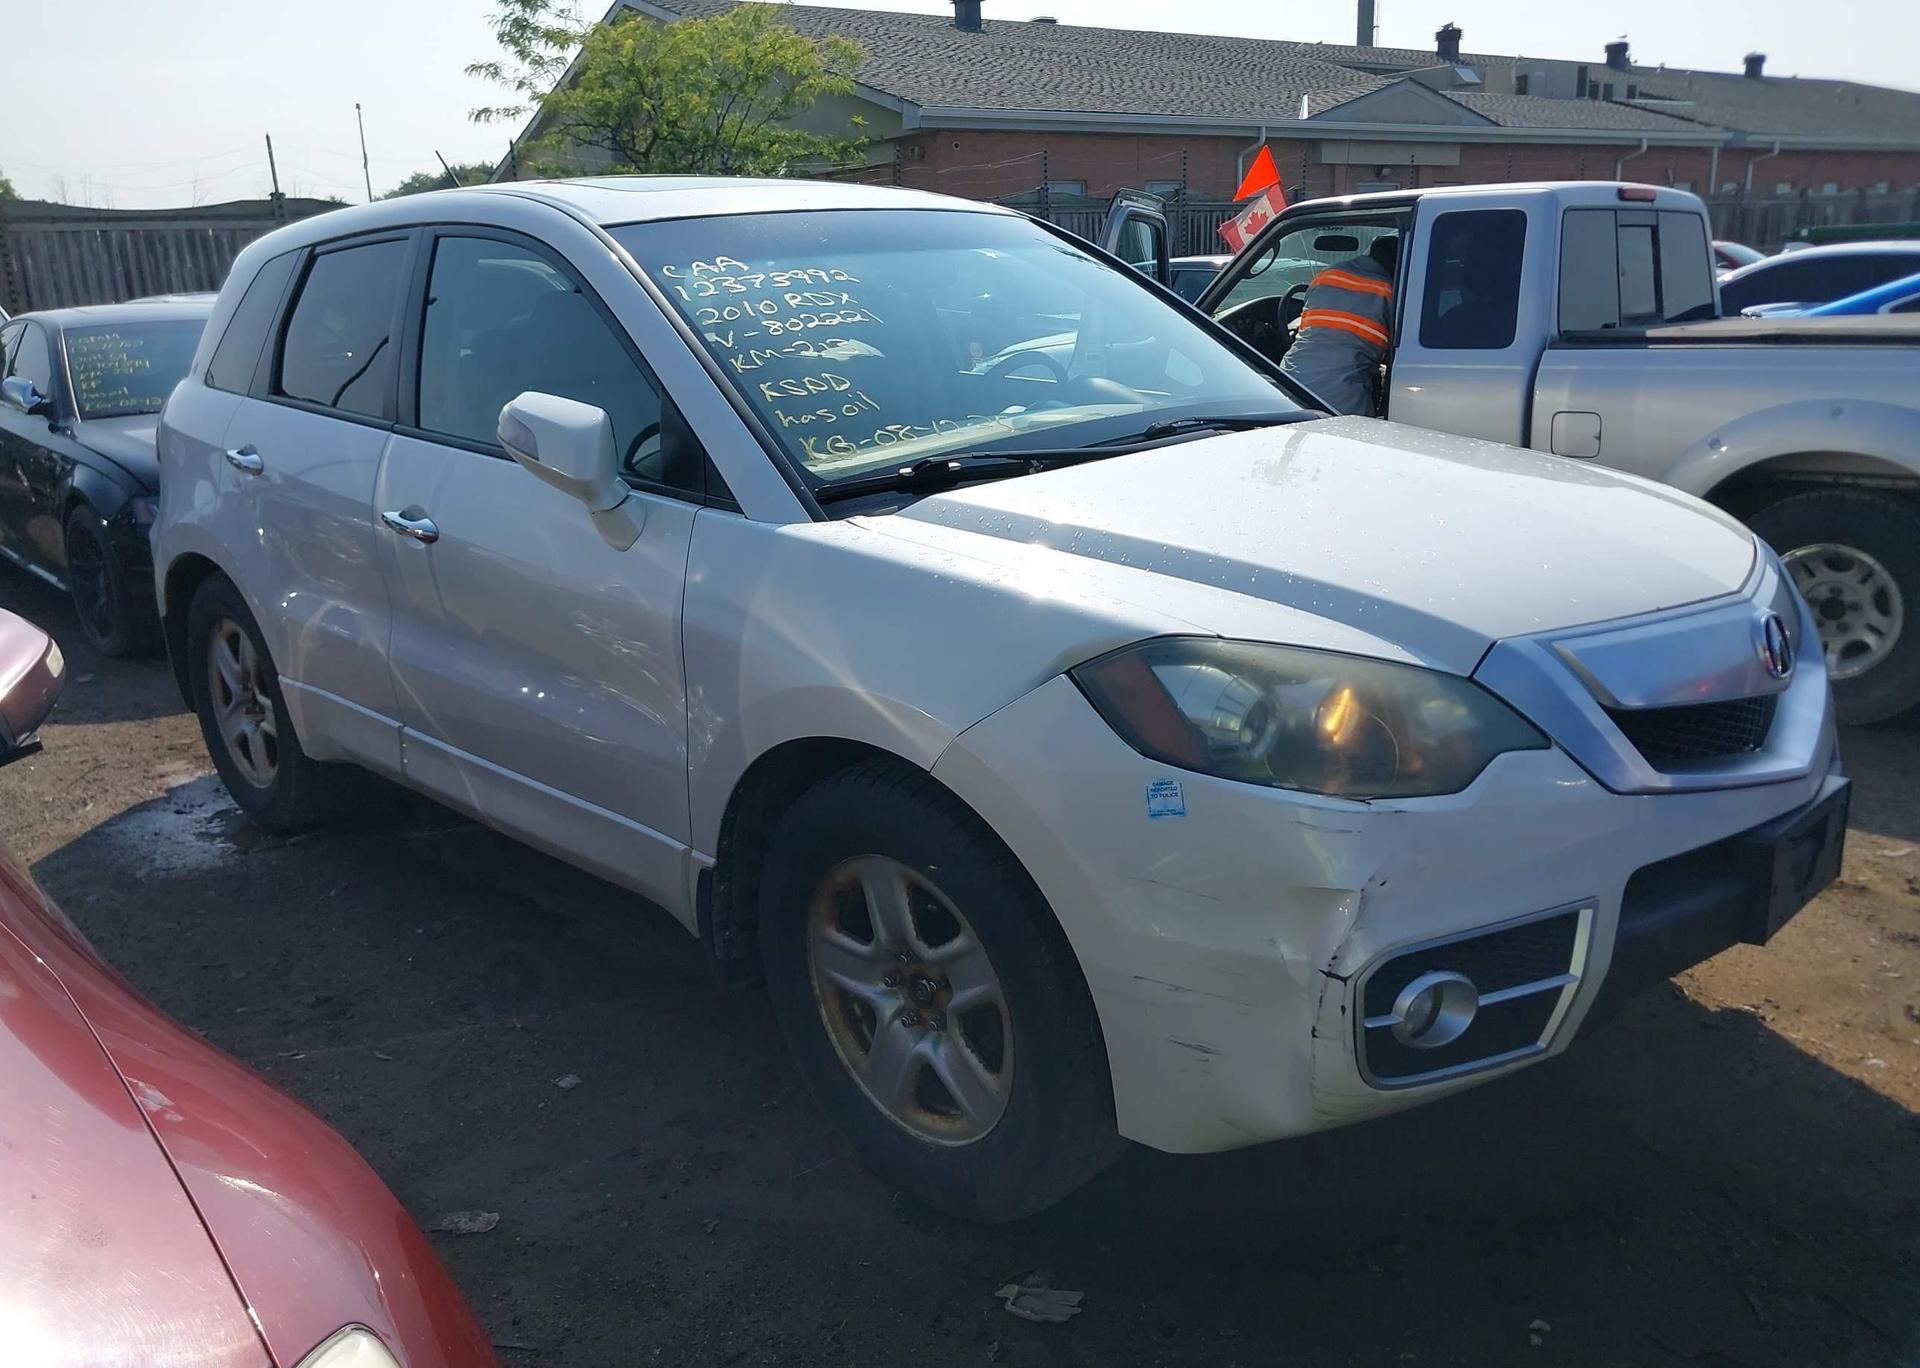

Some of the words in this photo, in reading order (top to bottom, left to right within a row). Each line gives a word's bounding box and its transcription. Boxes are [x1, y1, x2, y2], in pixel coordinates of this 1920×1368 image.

[662, 256, 749, 279] CAA
[675, 268, 860, 301] 12373992
[696, 300, 778, 326] 2010
[784, 291, 859, 308] RDX
[775, 408, 836, 428] has
[842, 391, 881, 416] oil
